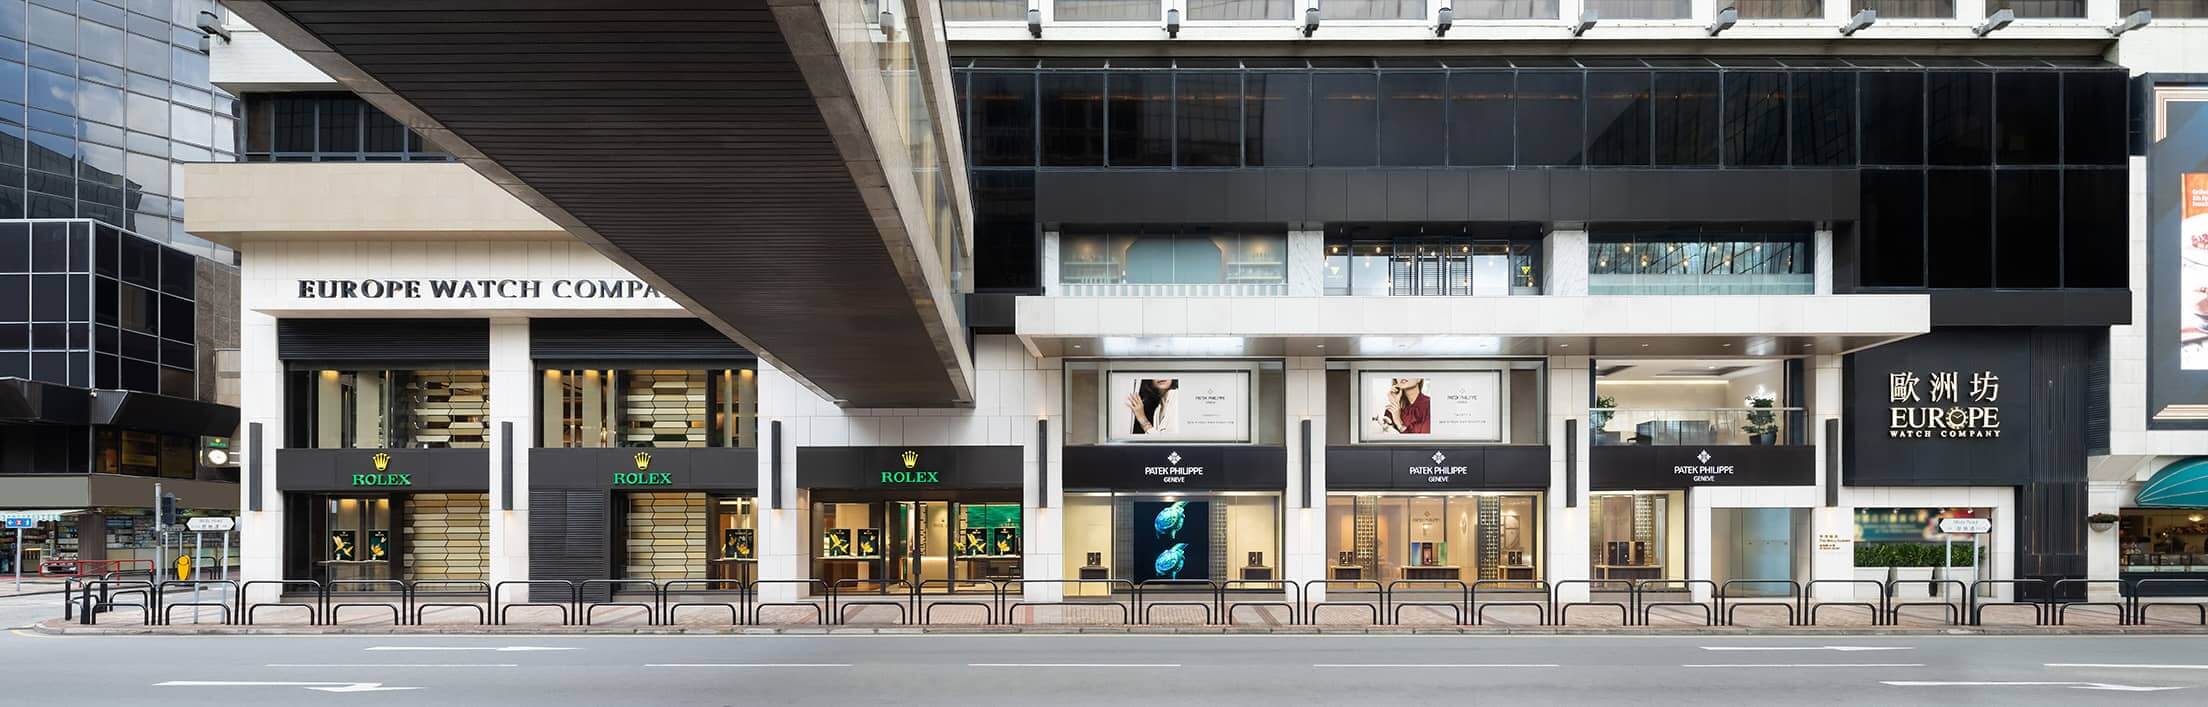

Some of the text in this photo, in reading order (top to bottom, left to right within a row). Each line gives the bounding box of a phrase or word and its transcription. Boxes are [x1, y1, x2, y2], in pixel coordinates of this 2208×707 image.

[298, 279, 422, 299] EUROPE
[429, 279, 543, 299] WATCH
[1889, 371, 2000, 403] 歐洲坊
[1889, 406, 2000, 430] EUROPE
[1889, 430, 2001, 438] WATCH COMPANY
[1145, 466, 1204, 476] PATEK PHILIPPE
[1409, 466, 1468, 474] PATEK PHILIPPE
[1674, 466, 1734, 474] PATEK PHILIPPE
[352, 473, 412, 486] ROLEX
[613, 472, 673, 485] ROLEX
[881, 471, 940, 483] ROLEX
